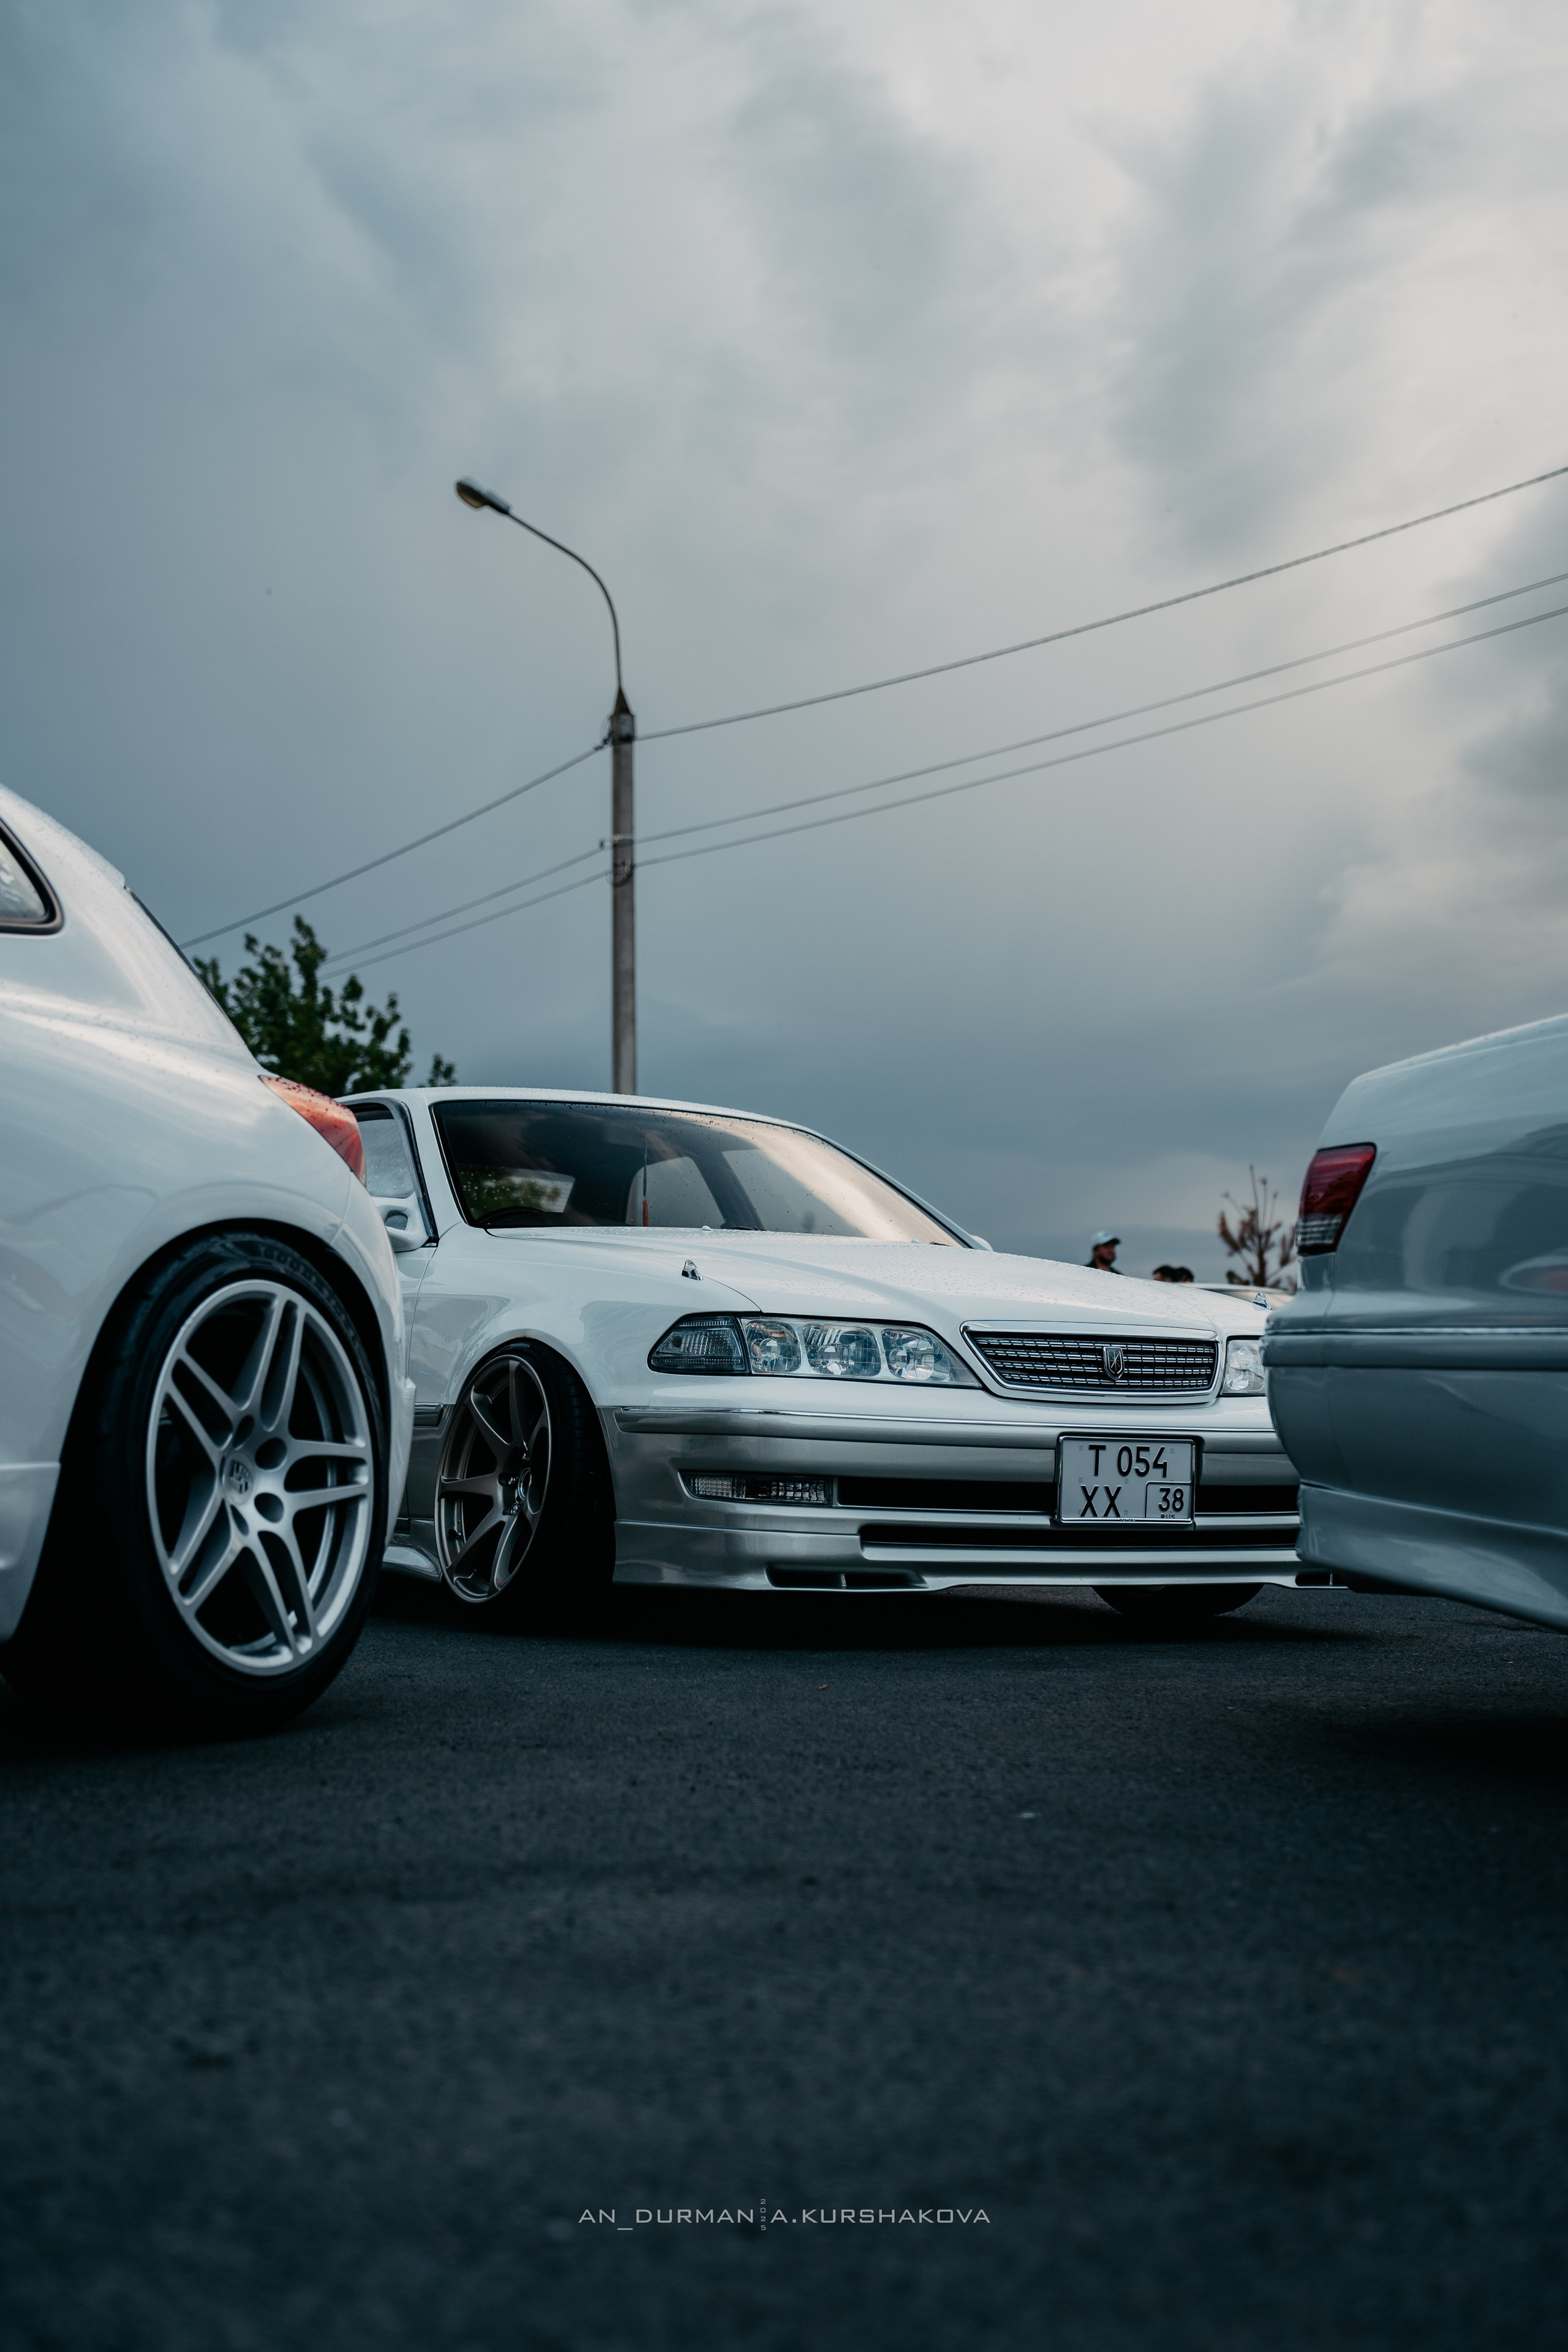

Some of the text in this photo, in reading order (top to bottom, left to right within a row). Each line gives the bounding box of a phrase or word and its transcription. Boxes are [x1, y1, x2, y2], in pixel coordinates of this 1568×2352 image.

[1088, 1444, 1167, 1479] T 054
[1080, 1485, 1122, 1518] XX
[1158, 1487, 1184, 1512] 38
